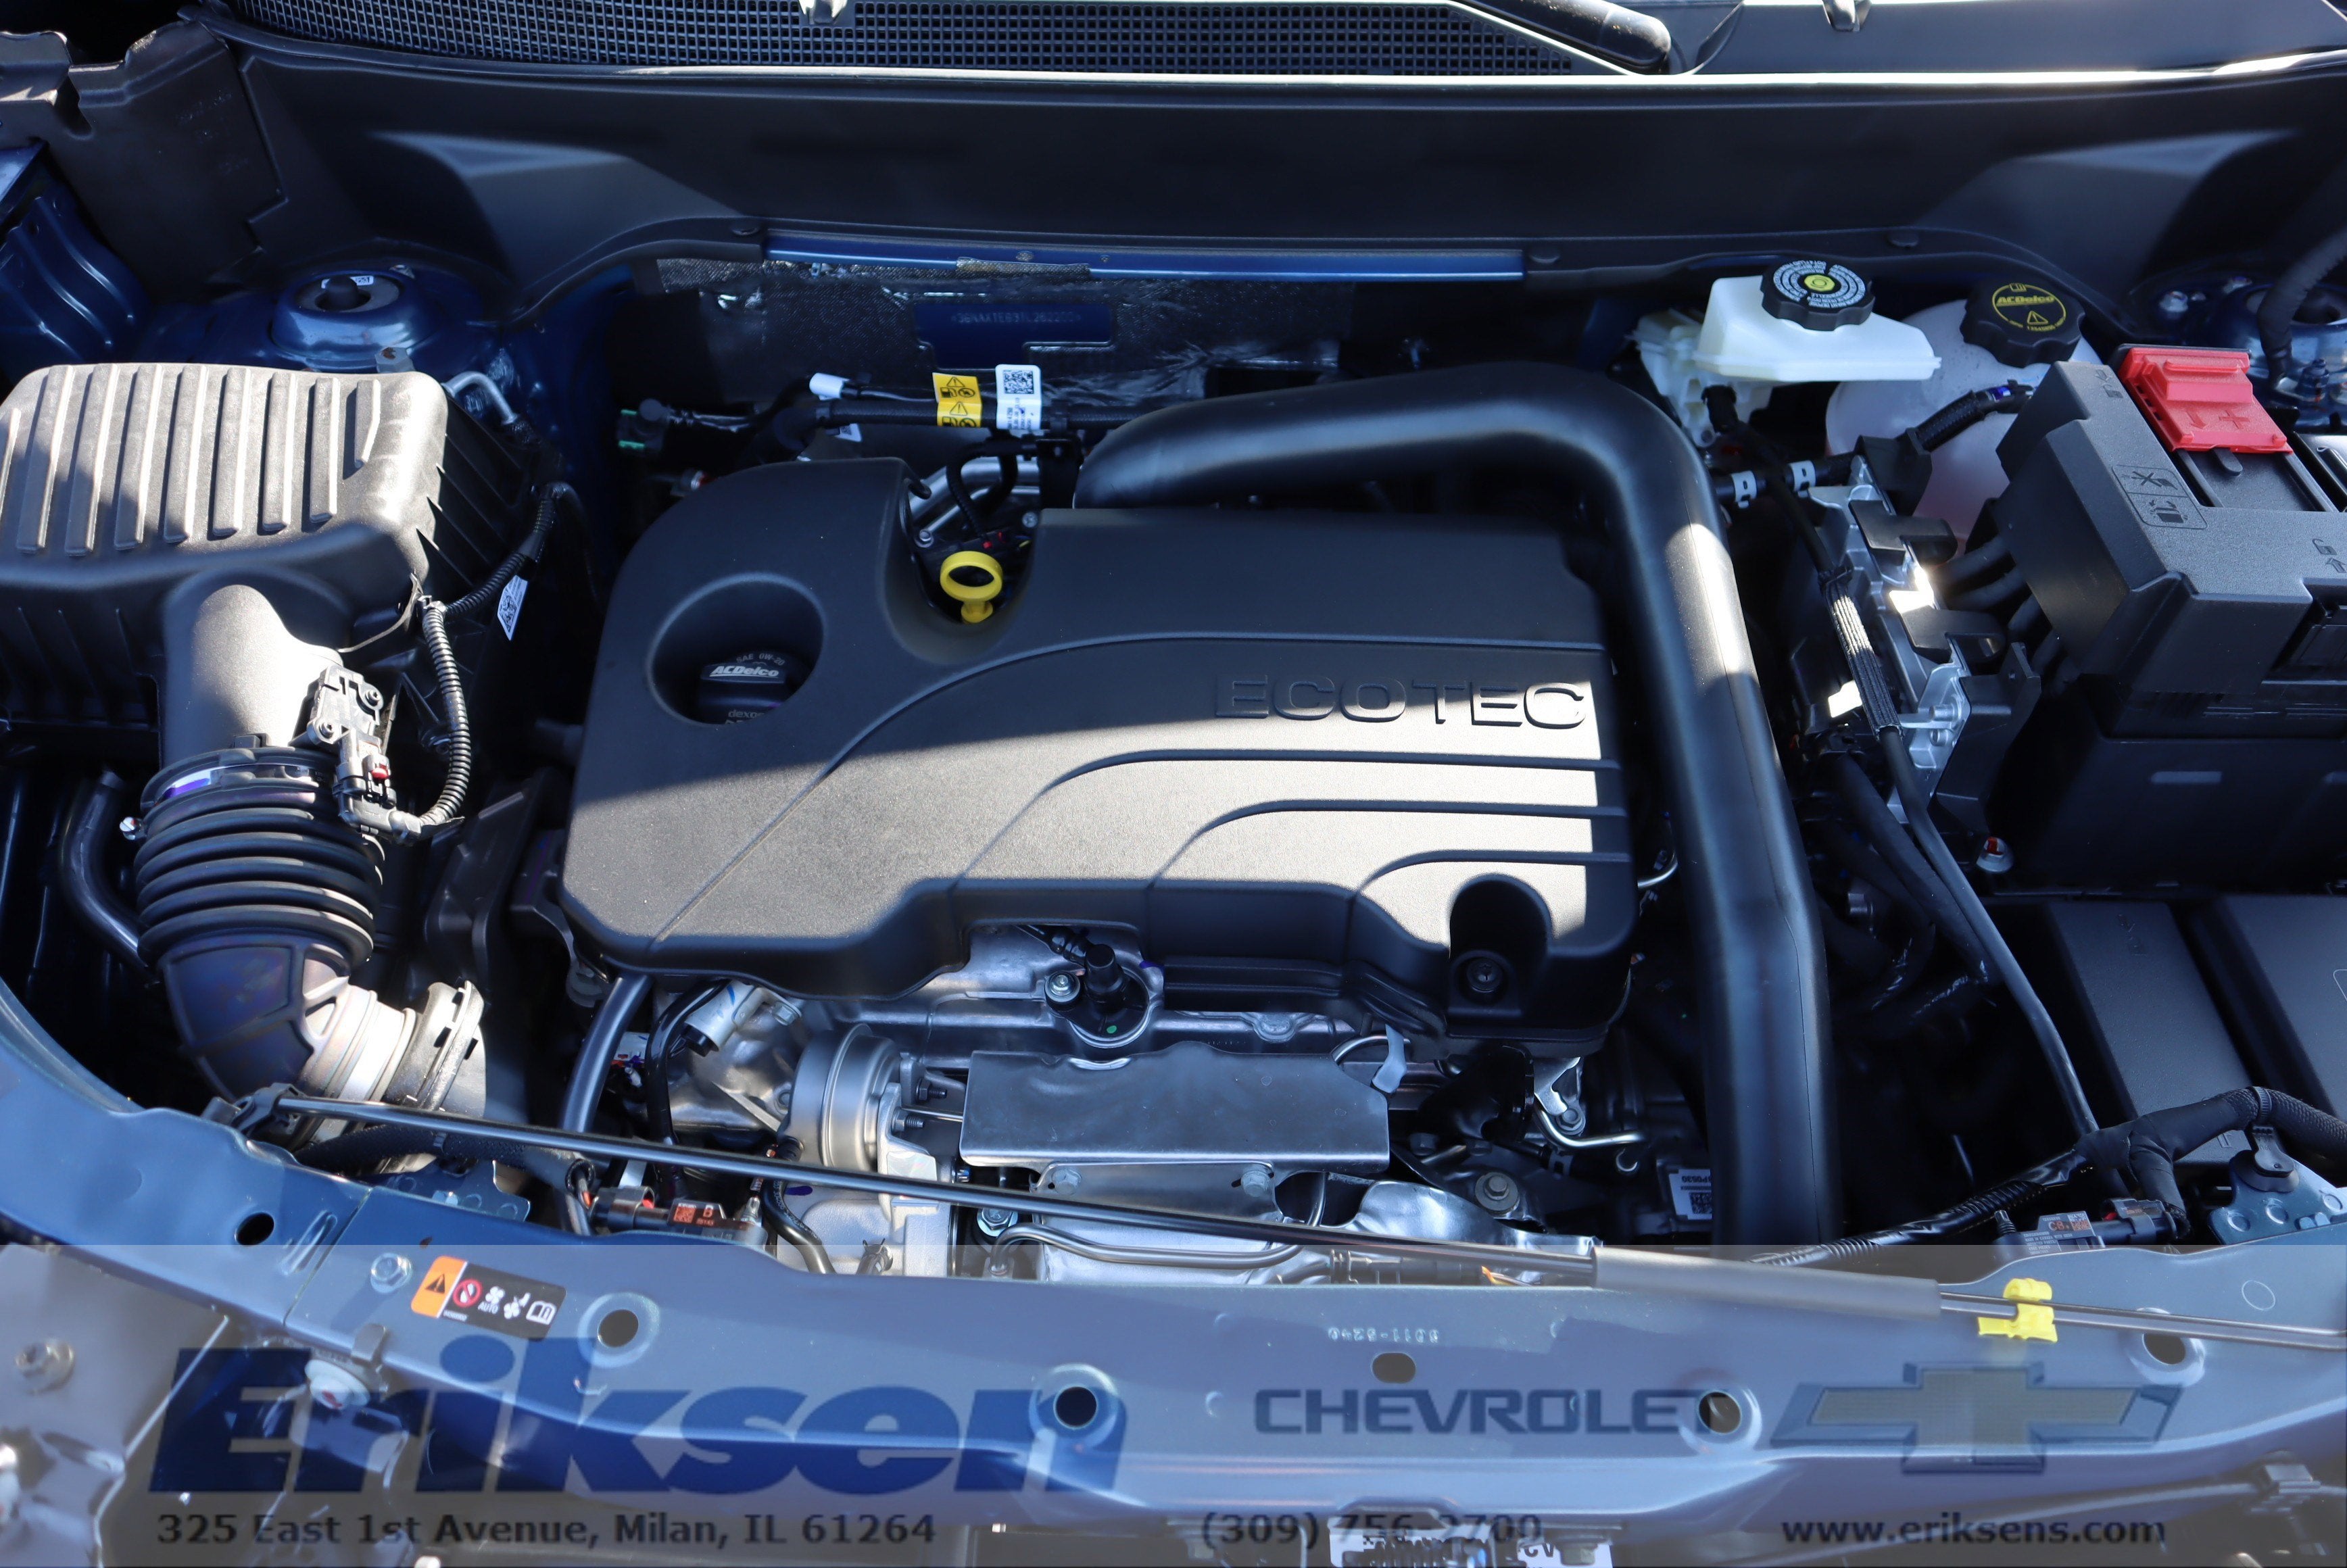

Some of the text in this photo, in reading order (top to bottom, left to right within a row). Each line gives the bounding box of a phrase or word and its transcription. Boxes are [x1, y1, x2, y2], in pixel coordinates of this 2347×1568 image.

[1996, 295, 2055, 306] ACDelco
[736, 653, 786, 666] SAE 0W-20
[709, 665, 779, 678] ACDelco
[1215, 675, 1586, 729] ECOTEC
[477, 1300, 500, 1314] AUTO
